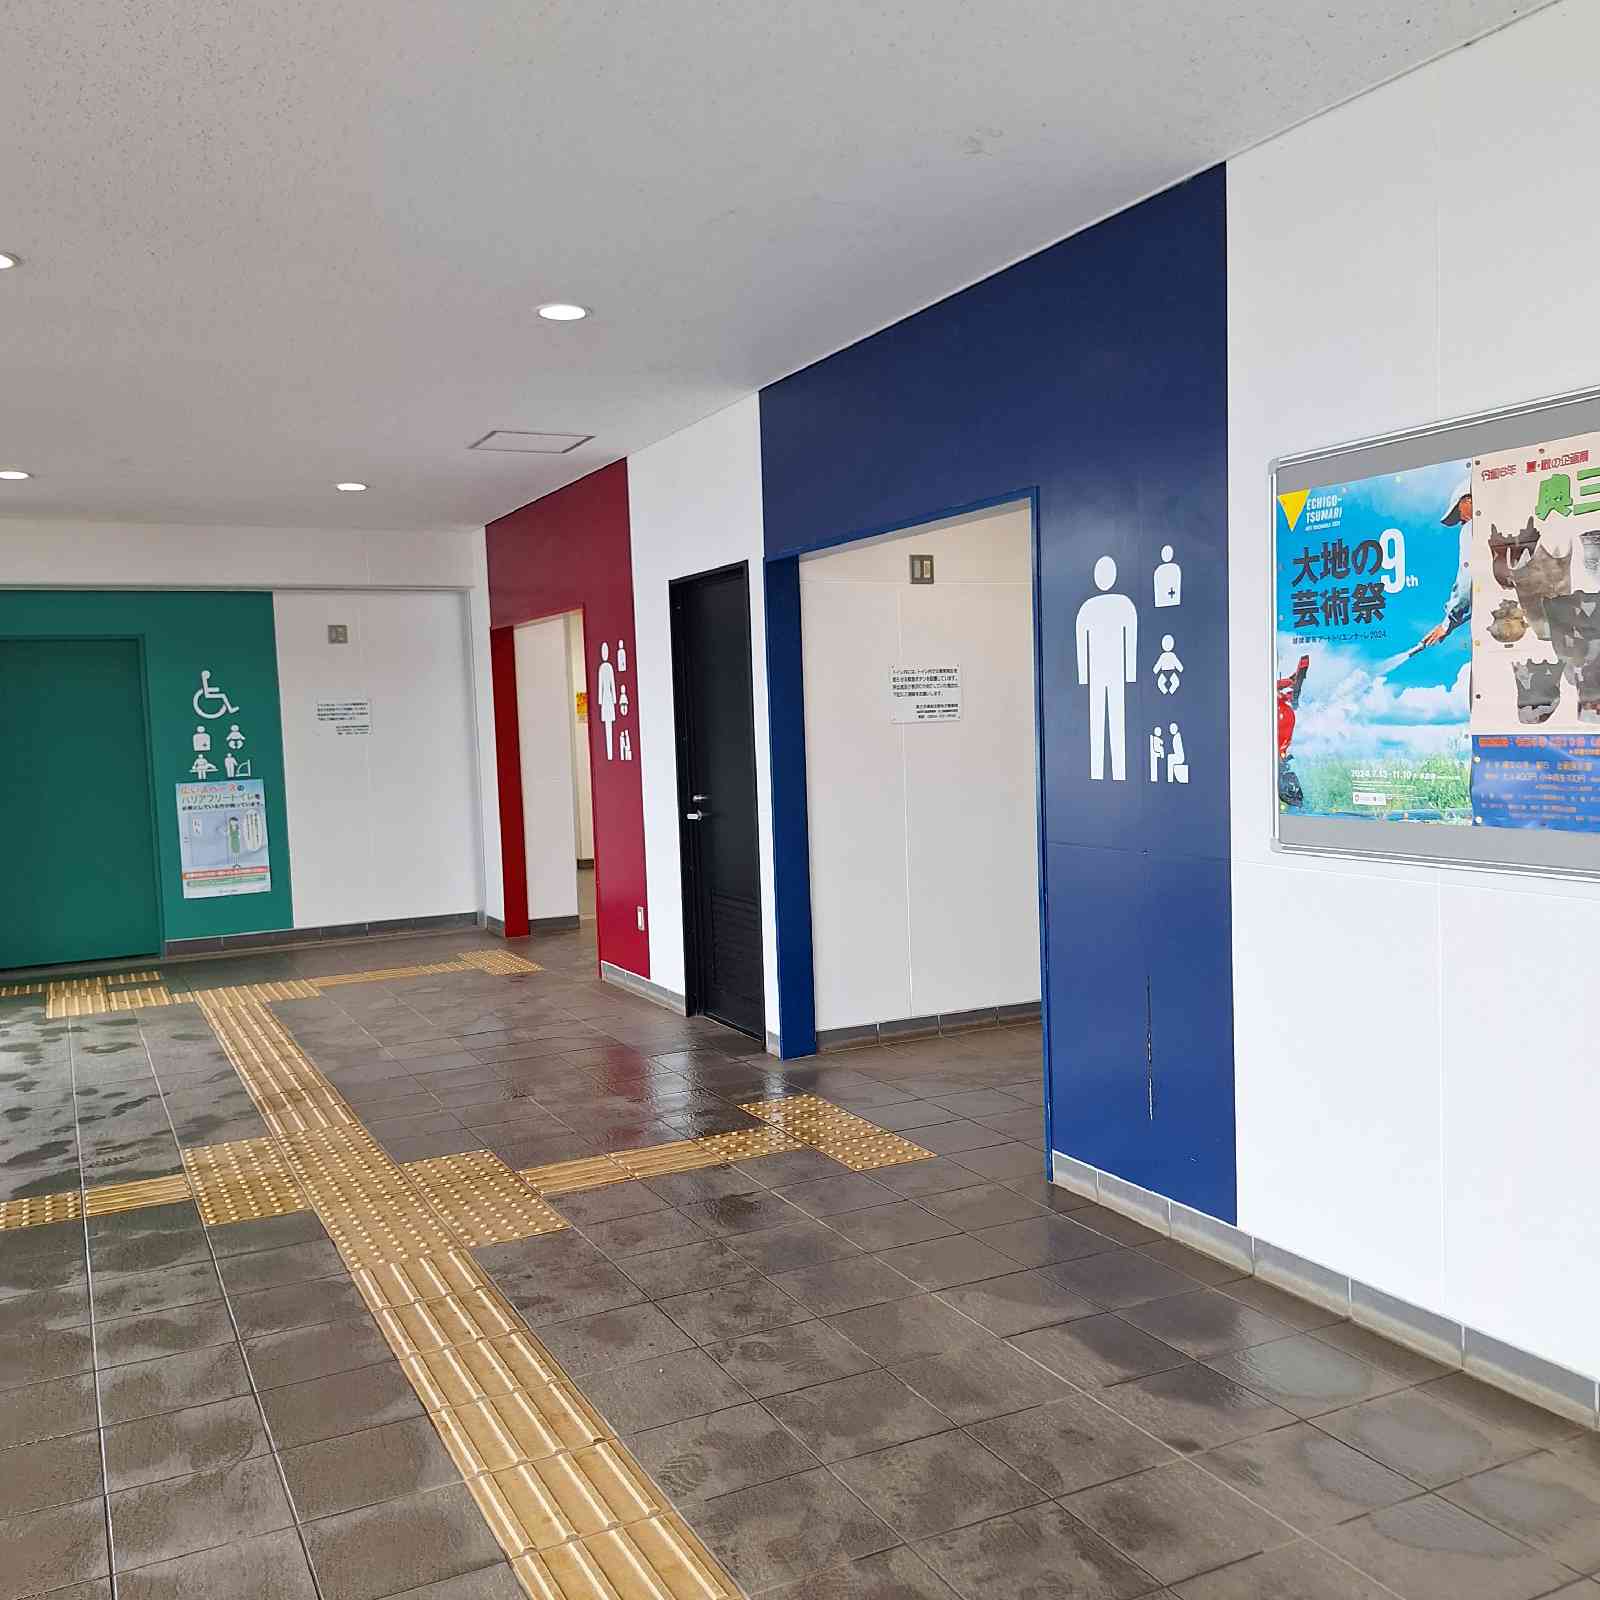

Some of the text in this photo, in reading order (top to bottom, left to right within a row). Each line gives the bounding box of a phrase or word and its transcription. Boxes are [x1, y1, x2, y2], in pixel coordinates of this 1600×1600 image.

[1306, 494, 1343, 511] ECHIGO-
[1306, 507, 1343, 524] TSUMARI
[1291, 538, 1384, 588] 大地の
[1291, 582, 1386, 628] 芸術祭
